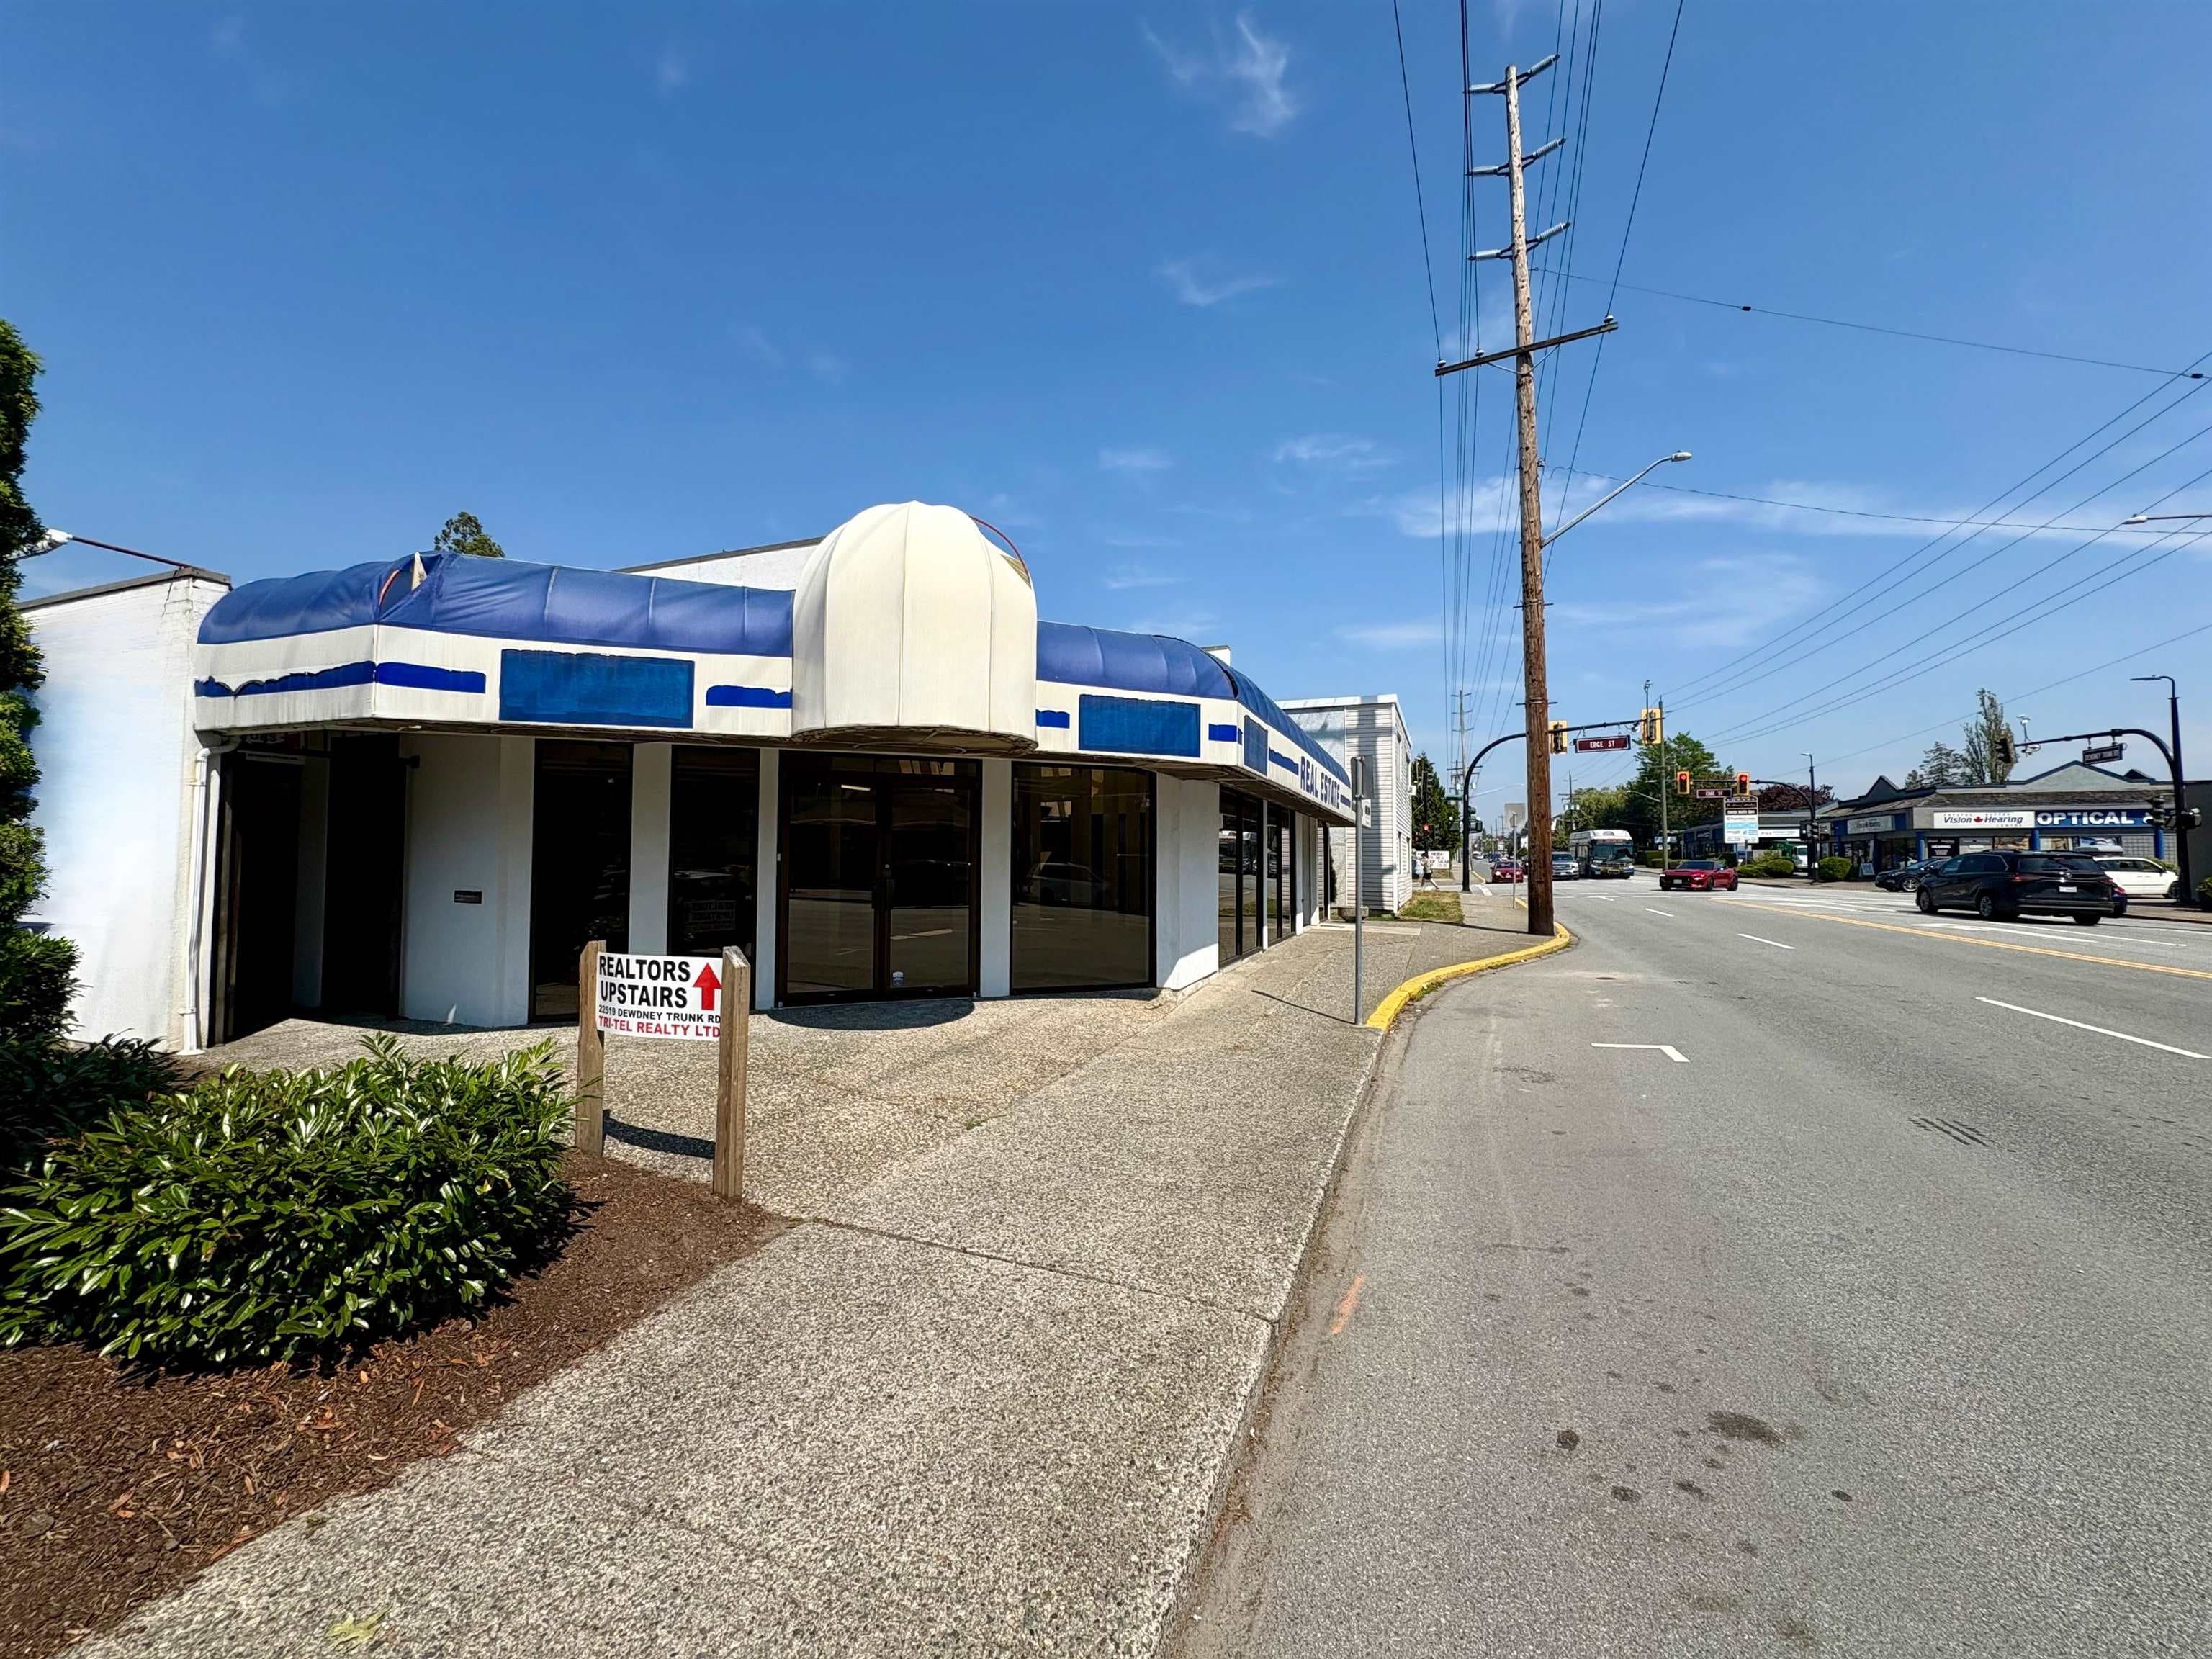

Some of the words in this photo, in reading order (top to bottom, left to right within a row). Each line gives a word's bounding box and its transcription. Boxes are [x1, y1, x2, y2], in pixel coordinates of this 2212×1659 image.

[1300, 756, 1318, 798] REAL
[1321, 772, 1340, 809] ESTATE
[1984, 815, 2023, 824] Hearing
[2036, 811, 2134, 825] OPTICAL
[599, 955, 691, 982] REALTORS
[601, 980, 688, 1008] UPSTAIRS
[599, 1004, 616, 1016] 22519
[618, 1008, 663, 1020] DEWDNEY
[666, 1012, 704, 1022] TRUNK
[708, 1015, 721, 1024] RD
[599, 1016, 632, 1032] TRI-TEL
[637, 1022, 690, 1036] REALTY
[696, 1025, 720, 1038] LTD
